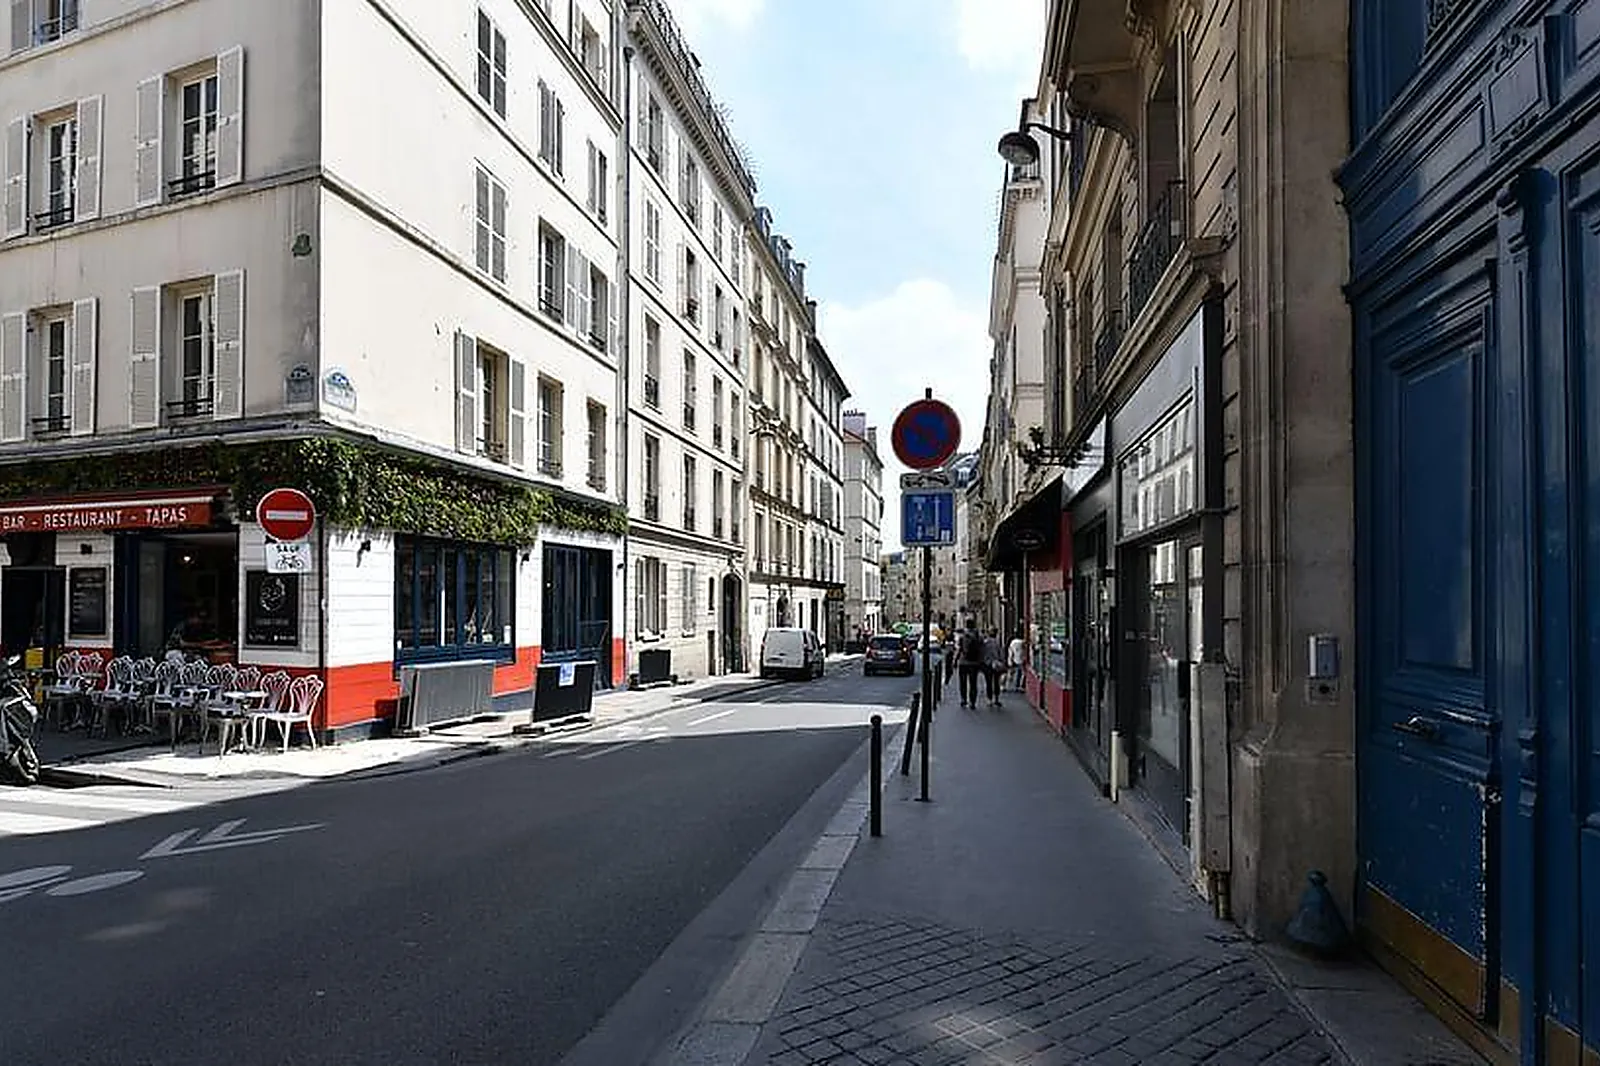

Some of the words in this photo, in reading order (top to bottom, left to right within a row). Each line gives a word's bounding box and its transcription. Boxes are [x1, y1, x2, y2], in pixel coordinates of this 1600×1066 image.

[3, 515, 25, 529] BAR
[43, 510, 122, 529] RESTAURANT
[145, 506, 187, 525] TAPAS
